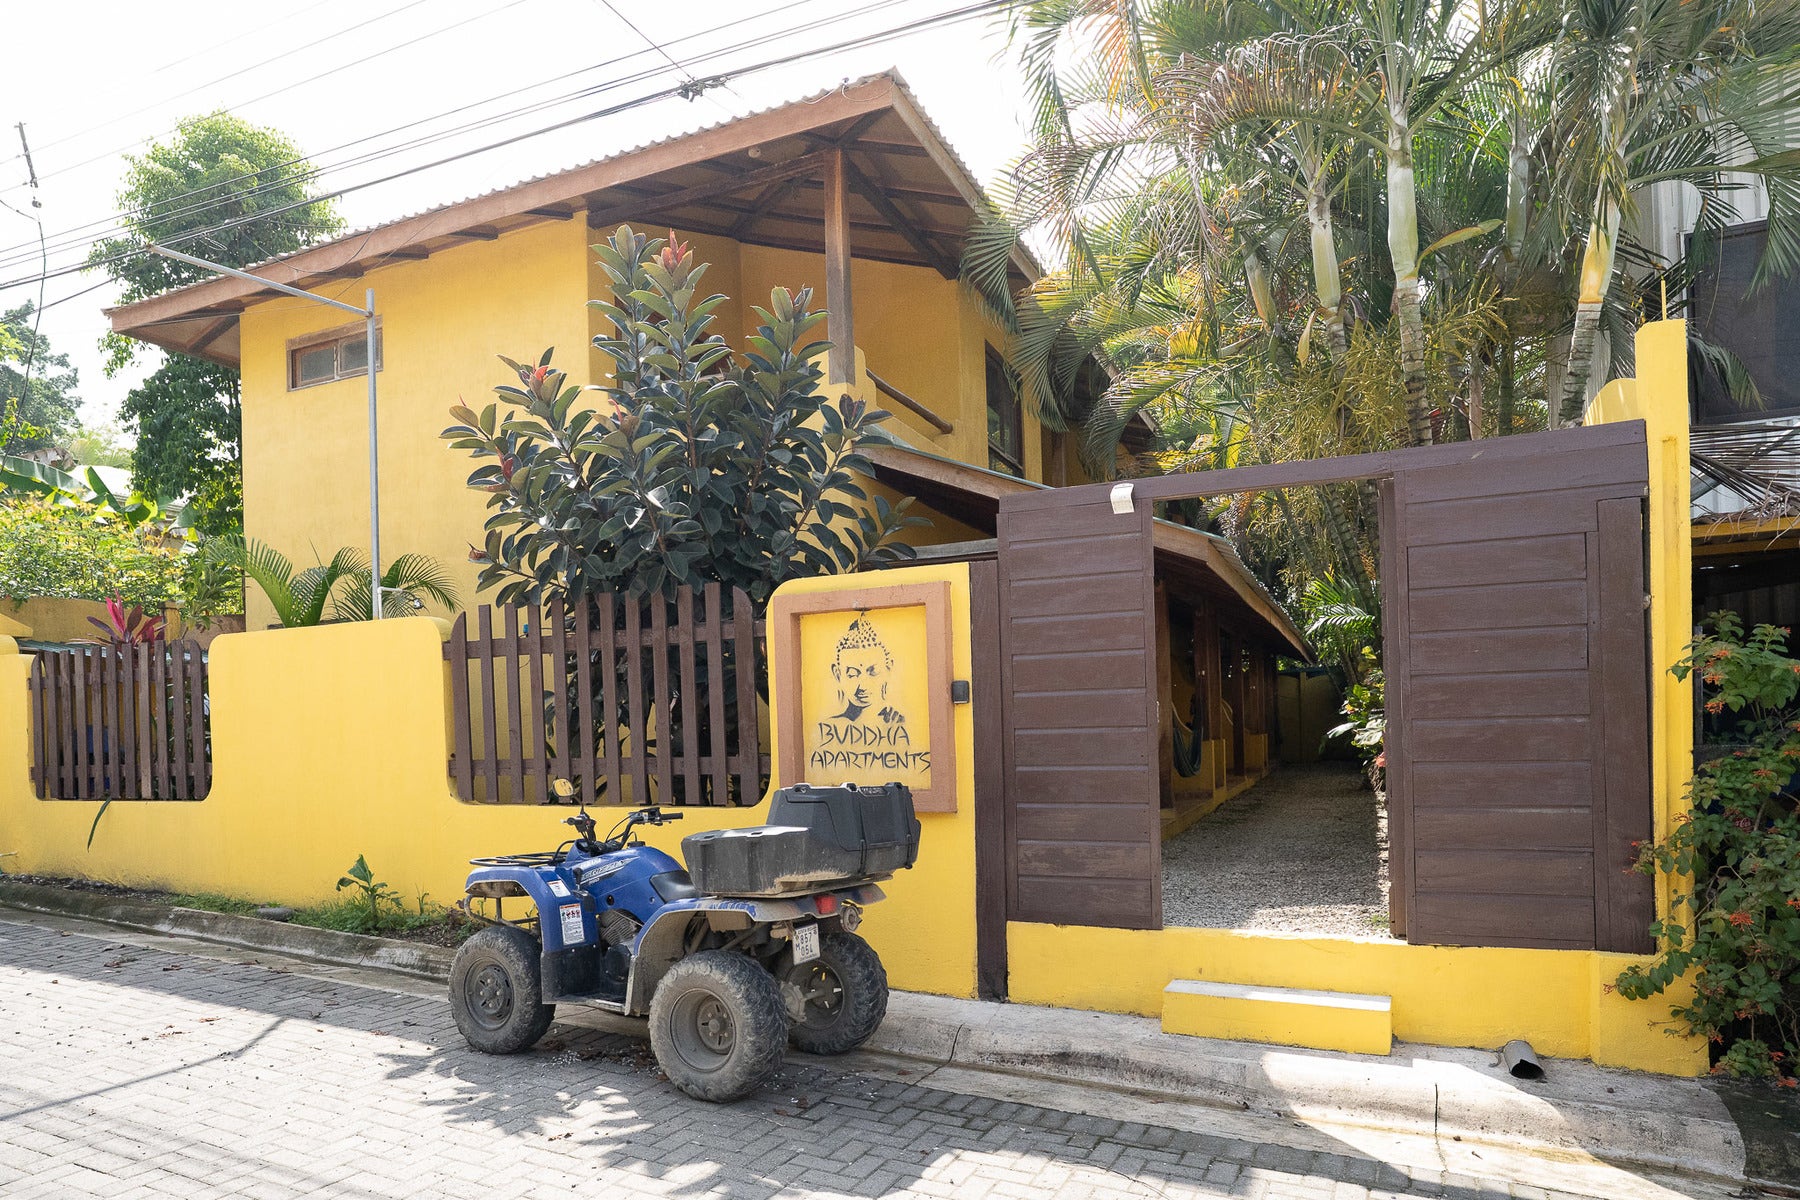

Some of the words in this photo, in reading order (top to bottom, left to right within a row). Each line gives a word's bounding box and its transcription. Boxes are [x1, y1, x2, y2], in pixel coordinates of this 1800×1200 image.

[818, 722, 910, 747] BUDDHA
[811, 750, 931, 774] APARTMENTS
[800, 932, 812, 944] 857
